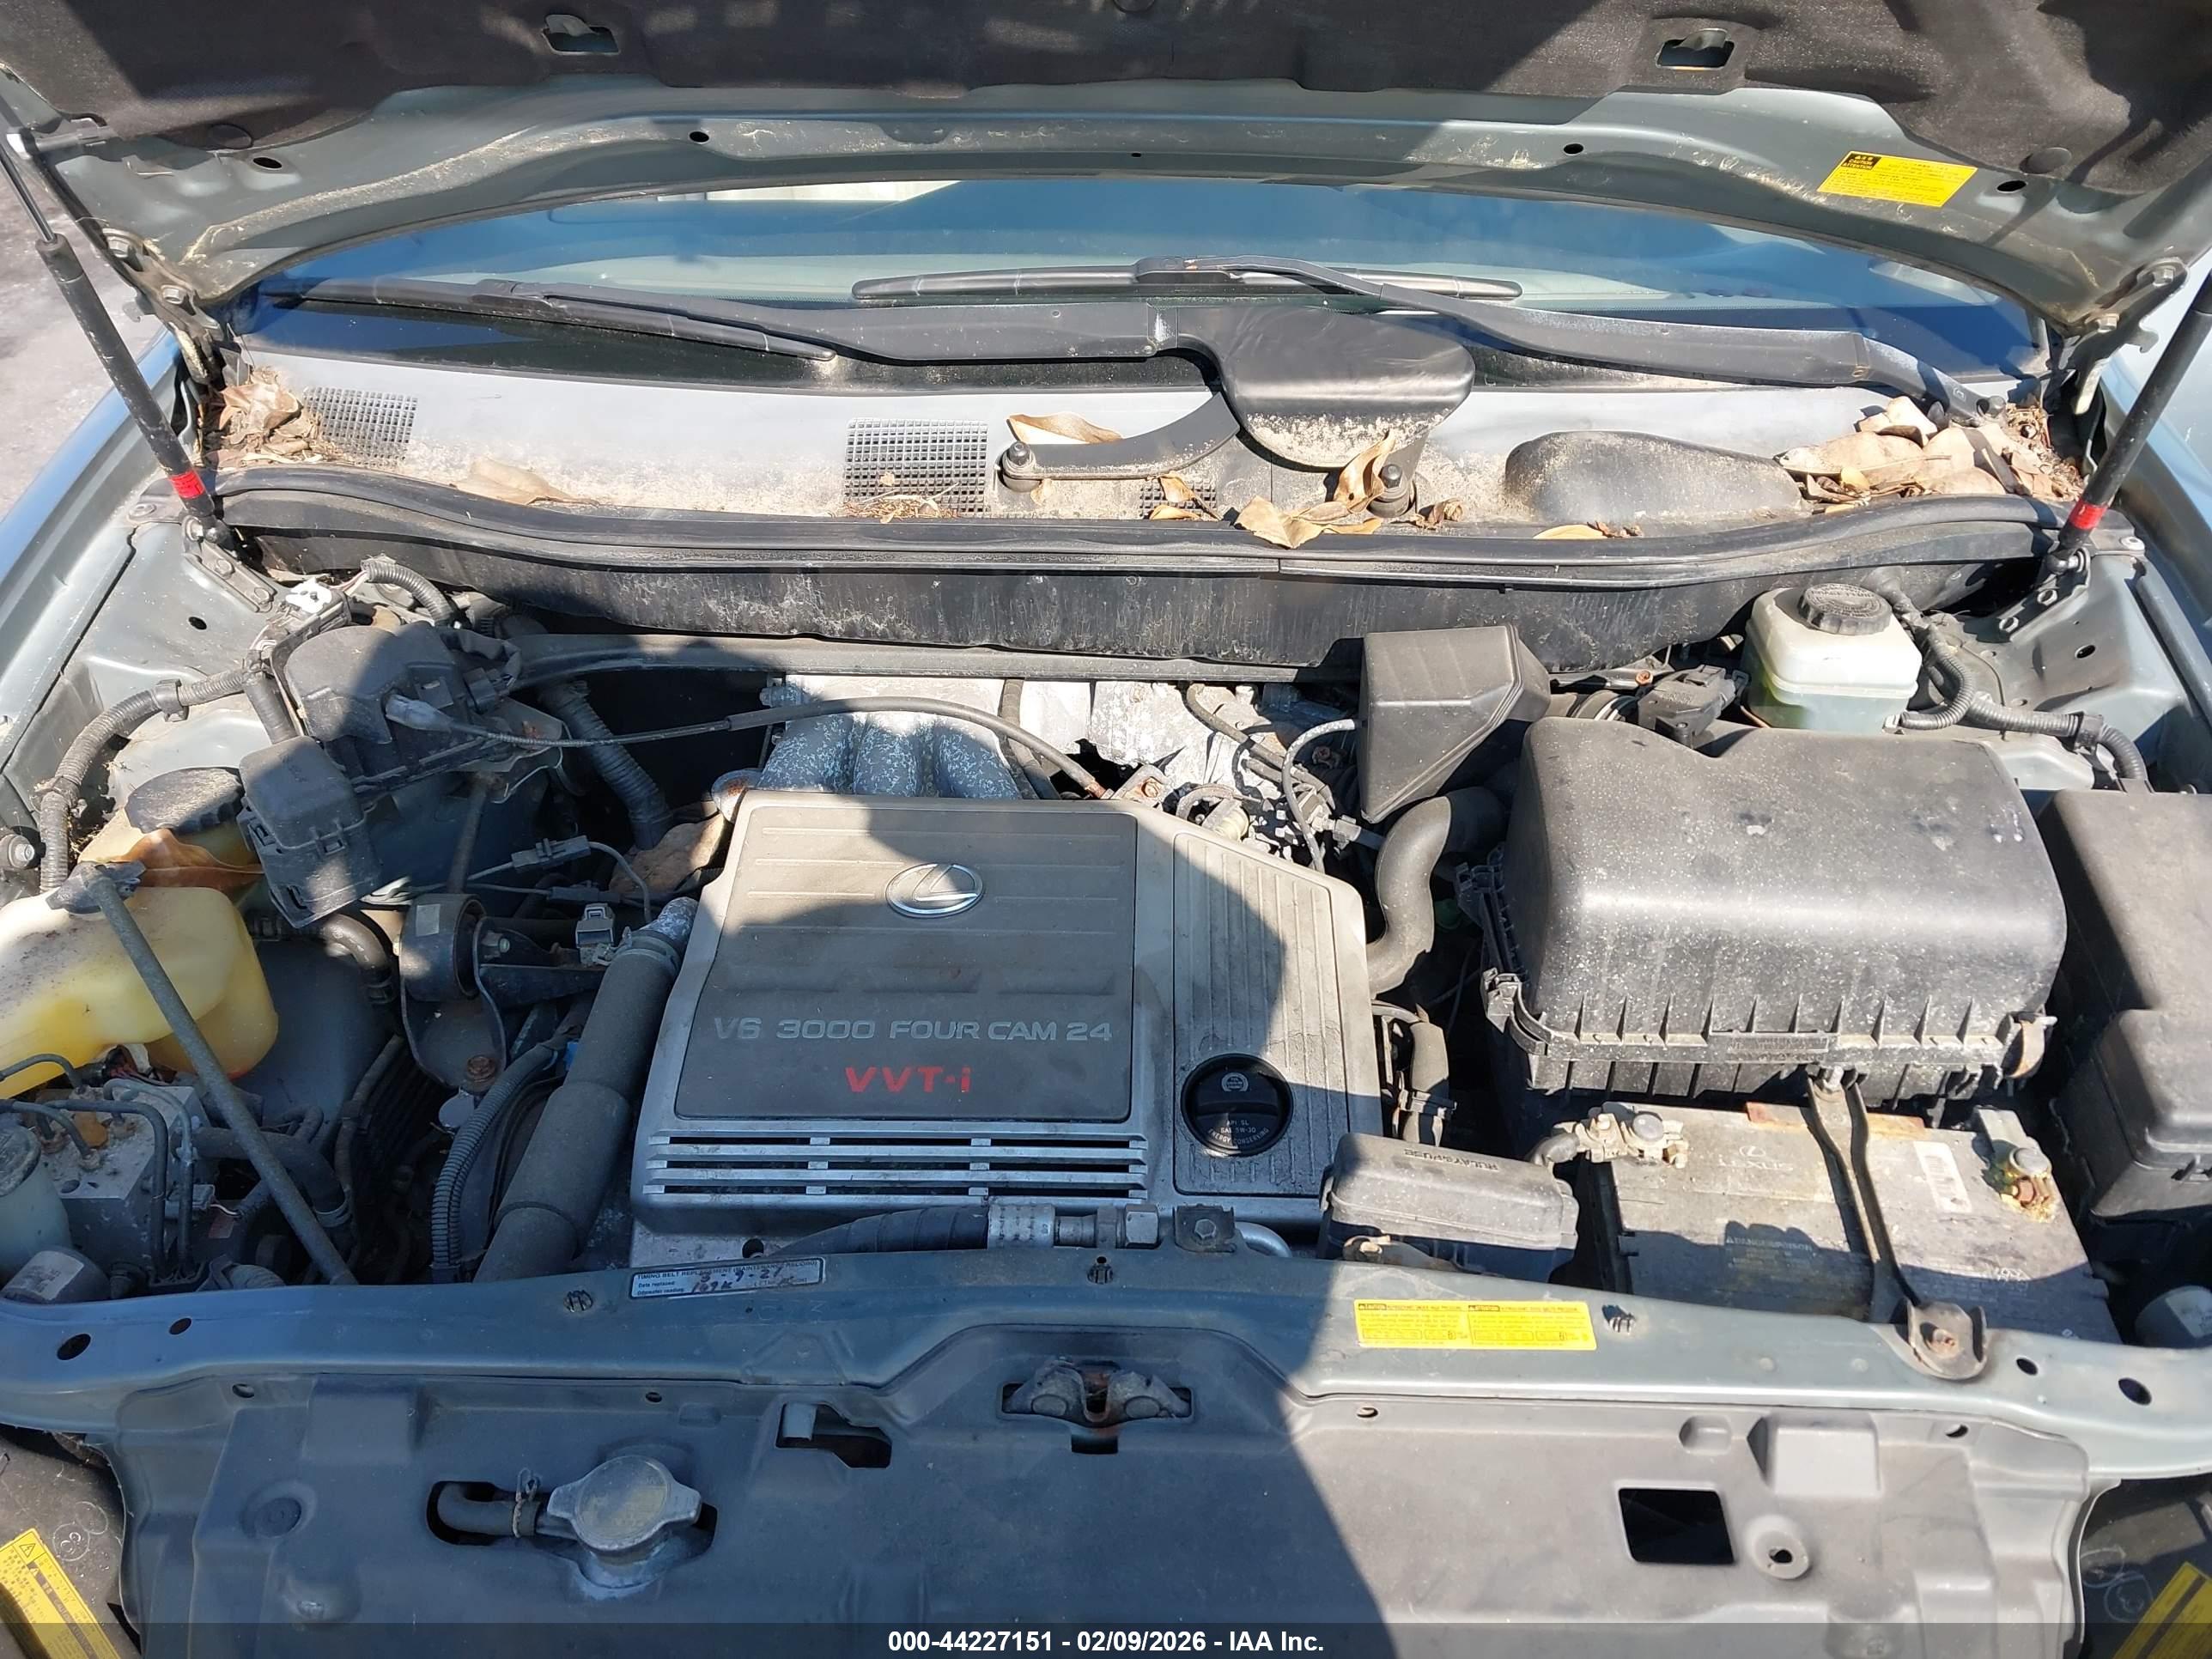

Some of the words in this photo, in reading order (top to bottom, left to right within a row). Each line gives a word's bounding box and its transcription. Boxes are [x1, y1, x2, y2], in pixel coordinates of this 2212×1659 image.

[714, 1017, 763, 1040] V6
[775, 1019, 876, 1040] 3000
[888, 1019, 981, 1040] FOUR
[987, 1020, 1058, 1041] CAM
[1066, 1022, 1113, 1042] 24
